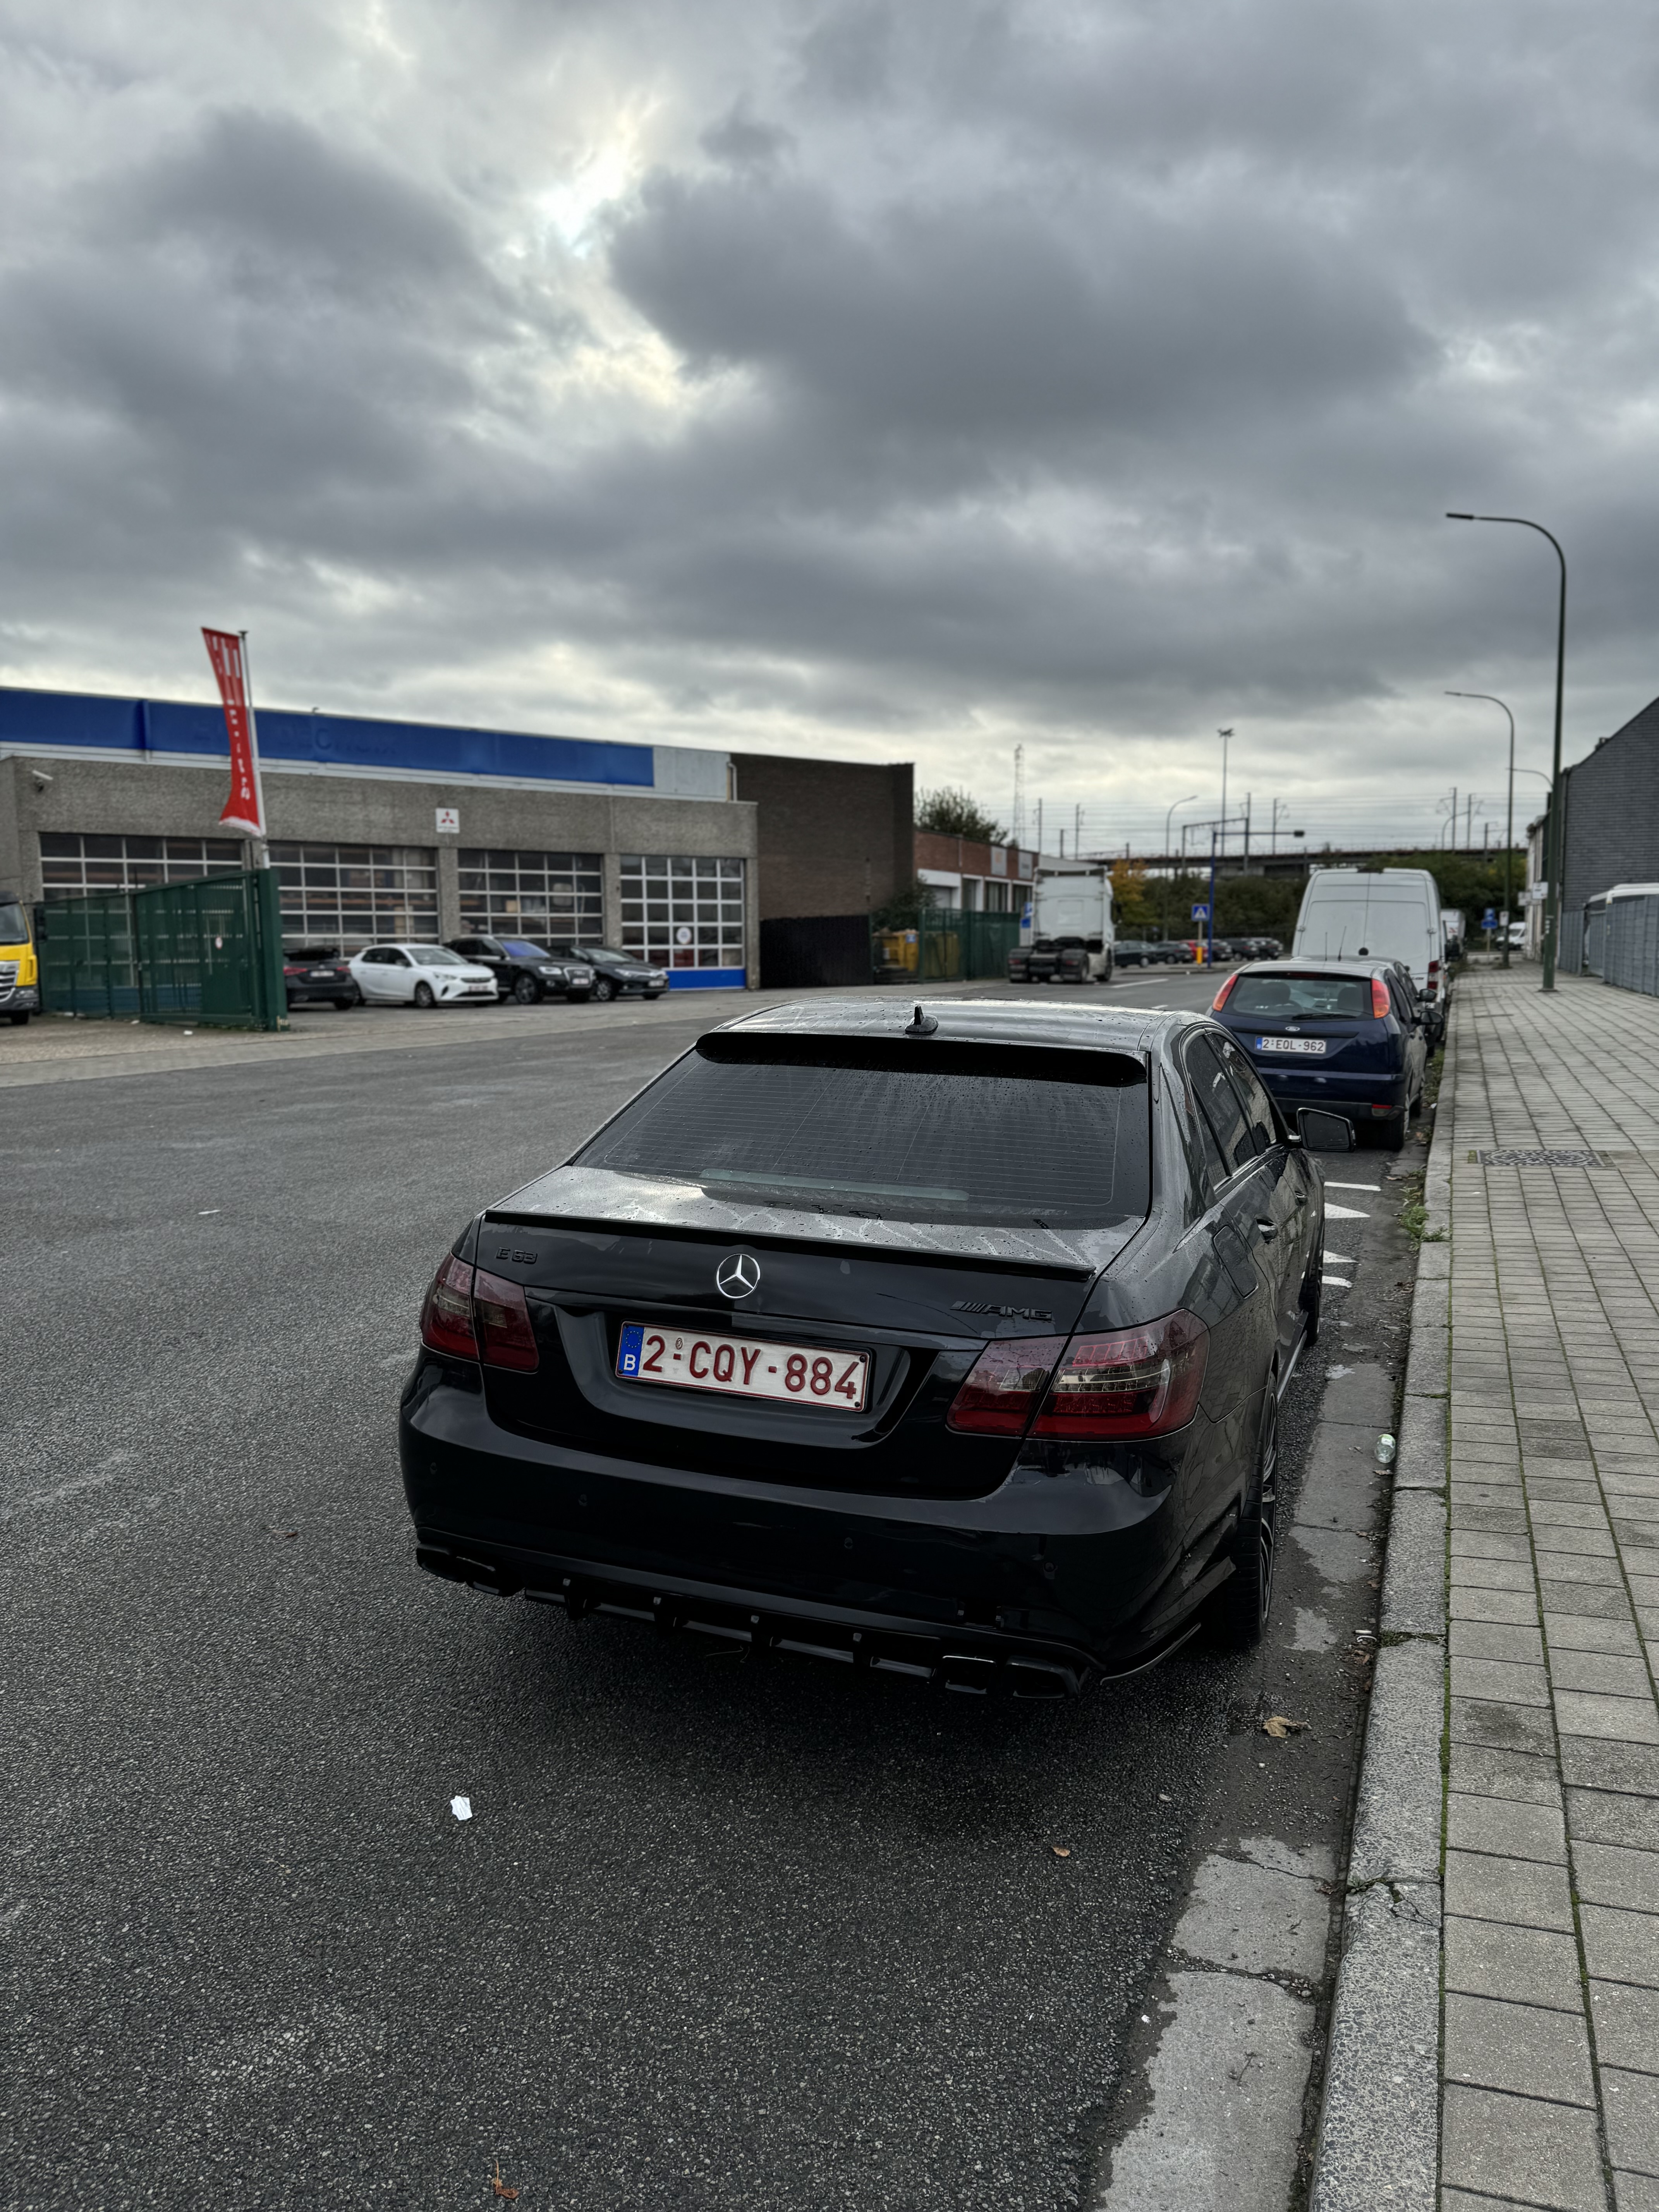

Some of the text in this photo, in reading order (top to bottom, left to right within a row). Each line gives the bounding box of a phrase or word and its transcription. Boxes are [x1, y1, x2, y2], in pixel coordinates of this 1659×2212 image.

[496, 1247, 538, 1265] E 63
[623, 1354, 636, 1370] B
